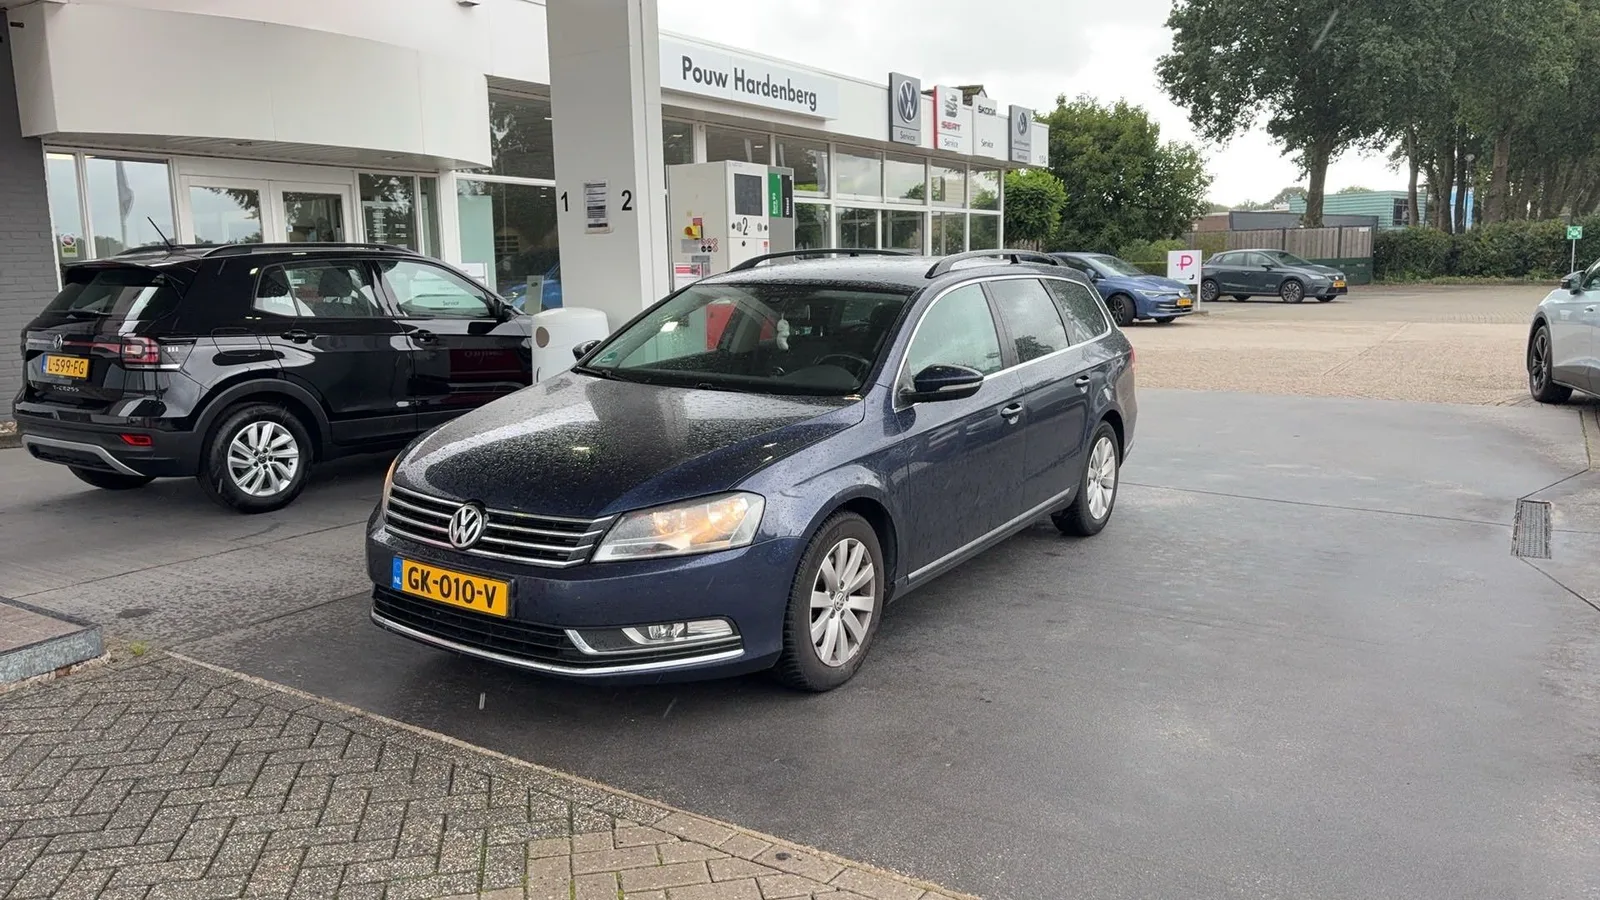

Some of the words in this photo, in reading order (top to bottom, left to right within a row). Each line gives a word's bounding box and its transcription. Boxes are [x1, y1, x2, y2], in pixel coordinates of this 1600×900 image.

[682, 56, 728, 88] Pouw
[734, 67, 817, 112] Hardenberg
[941, 121, 961, 131] SEAT
[900, 131, 916, 142] Service
[944, 138, 959, 149] Service
[981, 138, 994, 149] Service
[561, 191, 568, 212] 1
[621, 190, 633, 211] 2
[742, 217, 748, 236] 2
[48, 358, 84, 374] L-599-FG
[407, 566, 497, 609] GK-010-V
